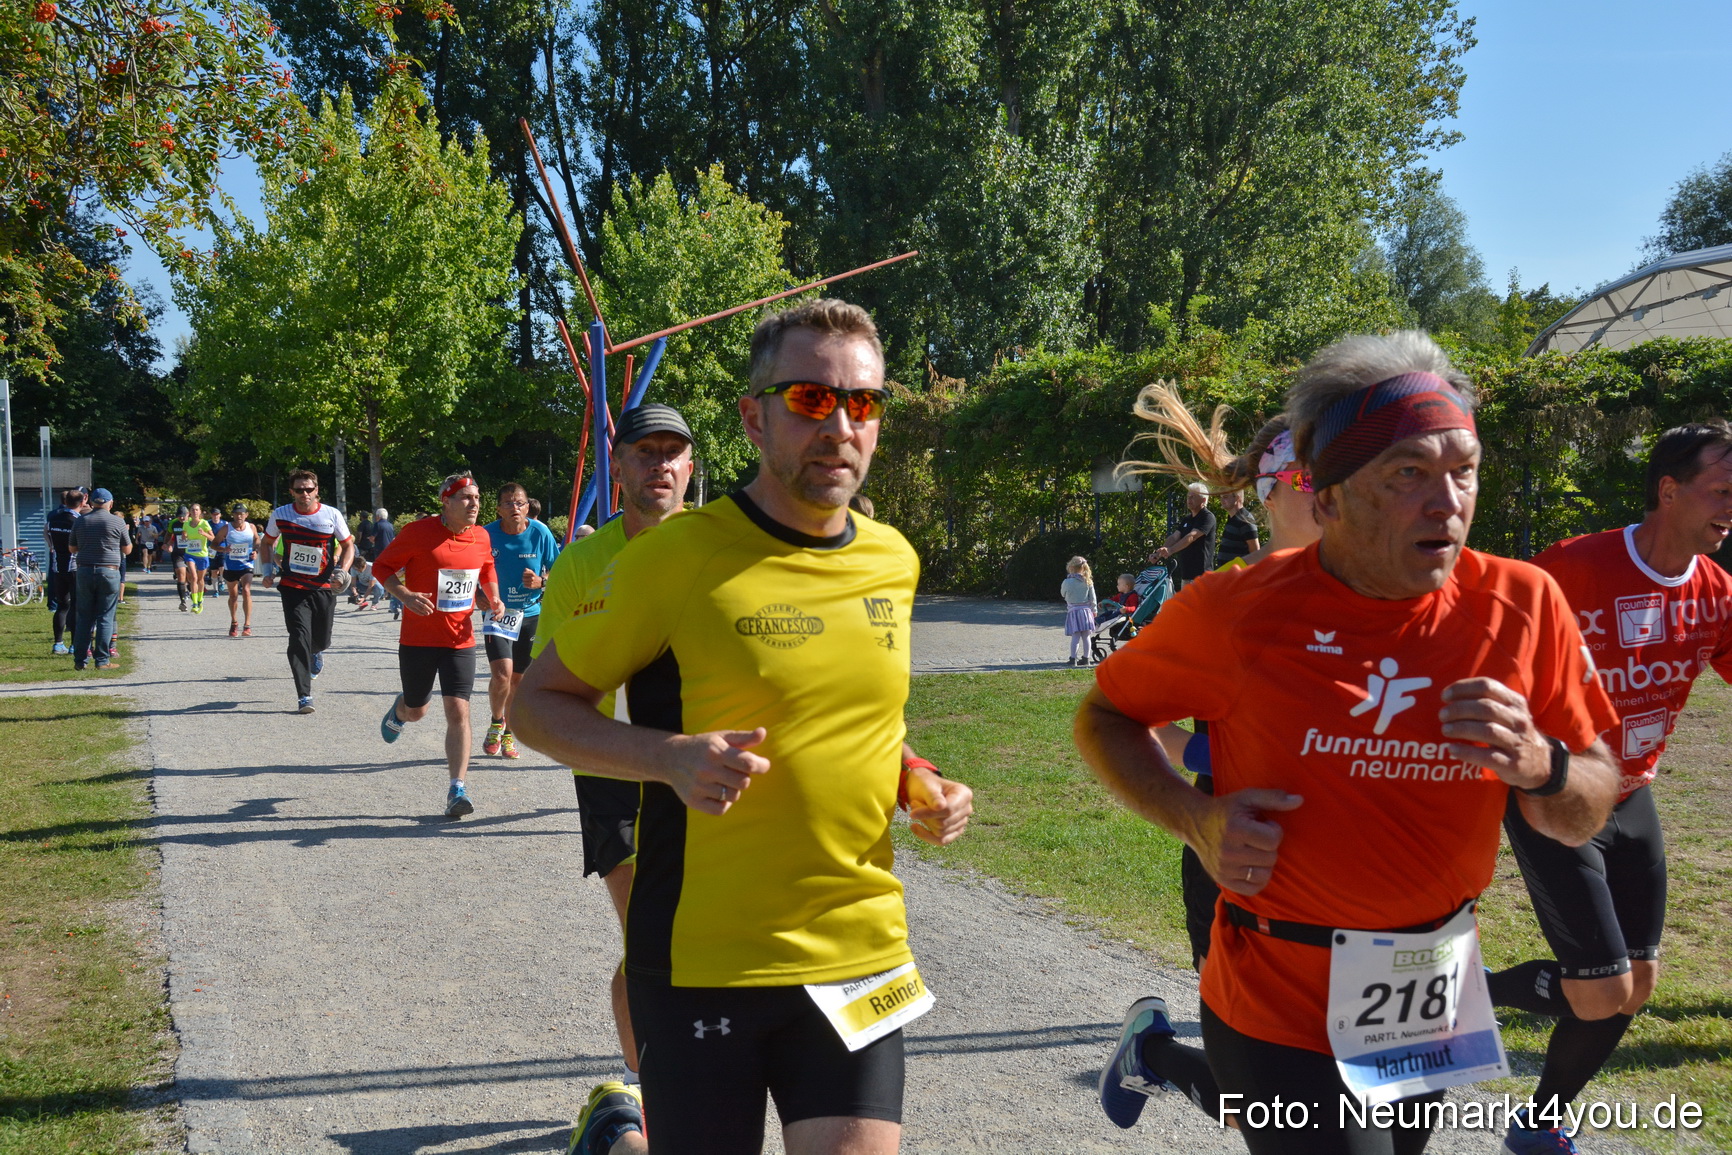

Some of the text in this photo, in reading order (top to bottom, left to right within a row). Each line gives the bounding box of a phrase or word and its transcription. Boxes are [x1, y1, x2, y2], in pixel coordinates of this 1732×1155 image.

[294, 551, 317, 564] 2519
[445, 580, 473, 595] 2310
[507, 586, 518, 595] 18.
[756, 604, 804, 618] PIZZERIA
[863, 597, 894, 620] MTP
[1619, 597, 1661, 610] raumbox
[747, 618, 814, 635] FRANCESCO
[1673, 628, 1717, 643] schenken
[1306, 644, 1343, 655] erima
[1626, 713, 1665, 729] raumbox
[1300, 727, 1457, 761] funrunner
[1591, 963, 1618, 977] cep
[842, 976, 874, 996] PARTL
[868, 978, 921, 1016] Rainer
[1364, 1024, 1450, 1045] PARTL Neumarkt
[1375, 1044, 1454, 1080] Hartmut
